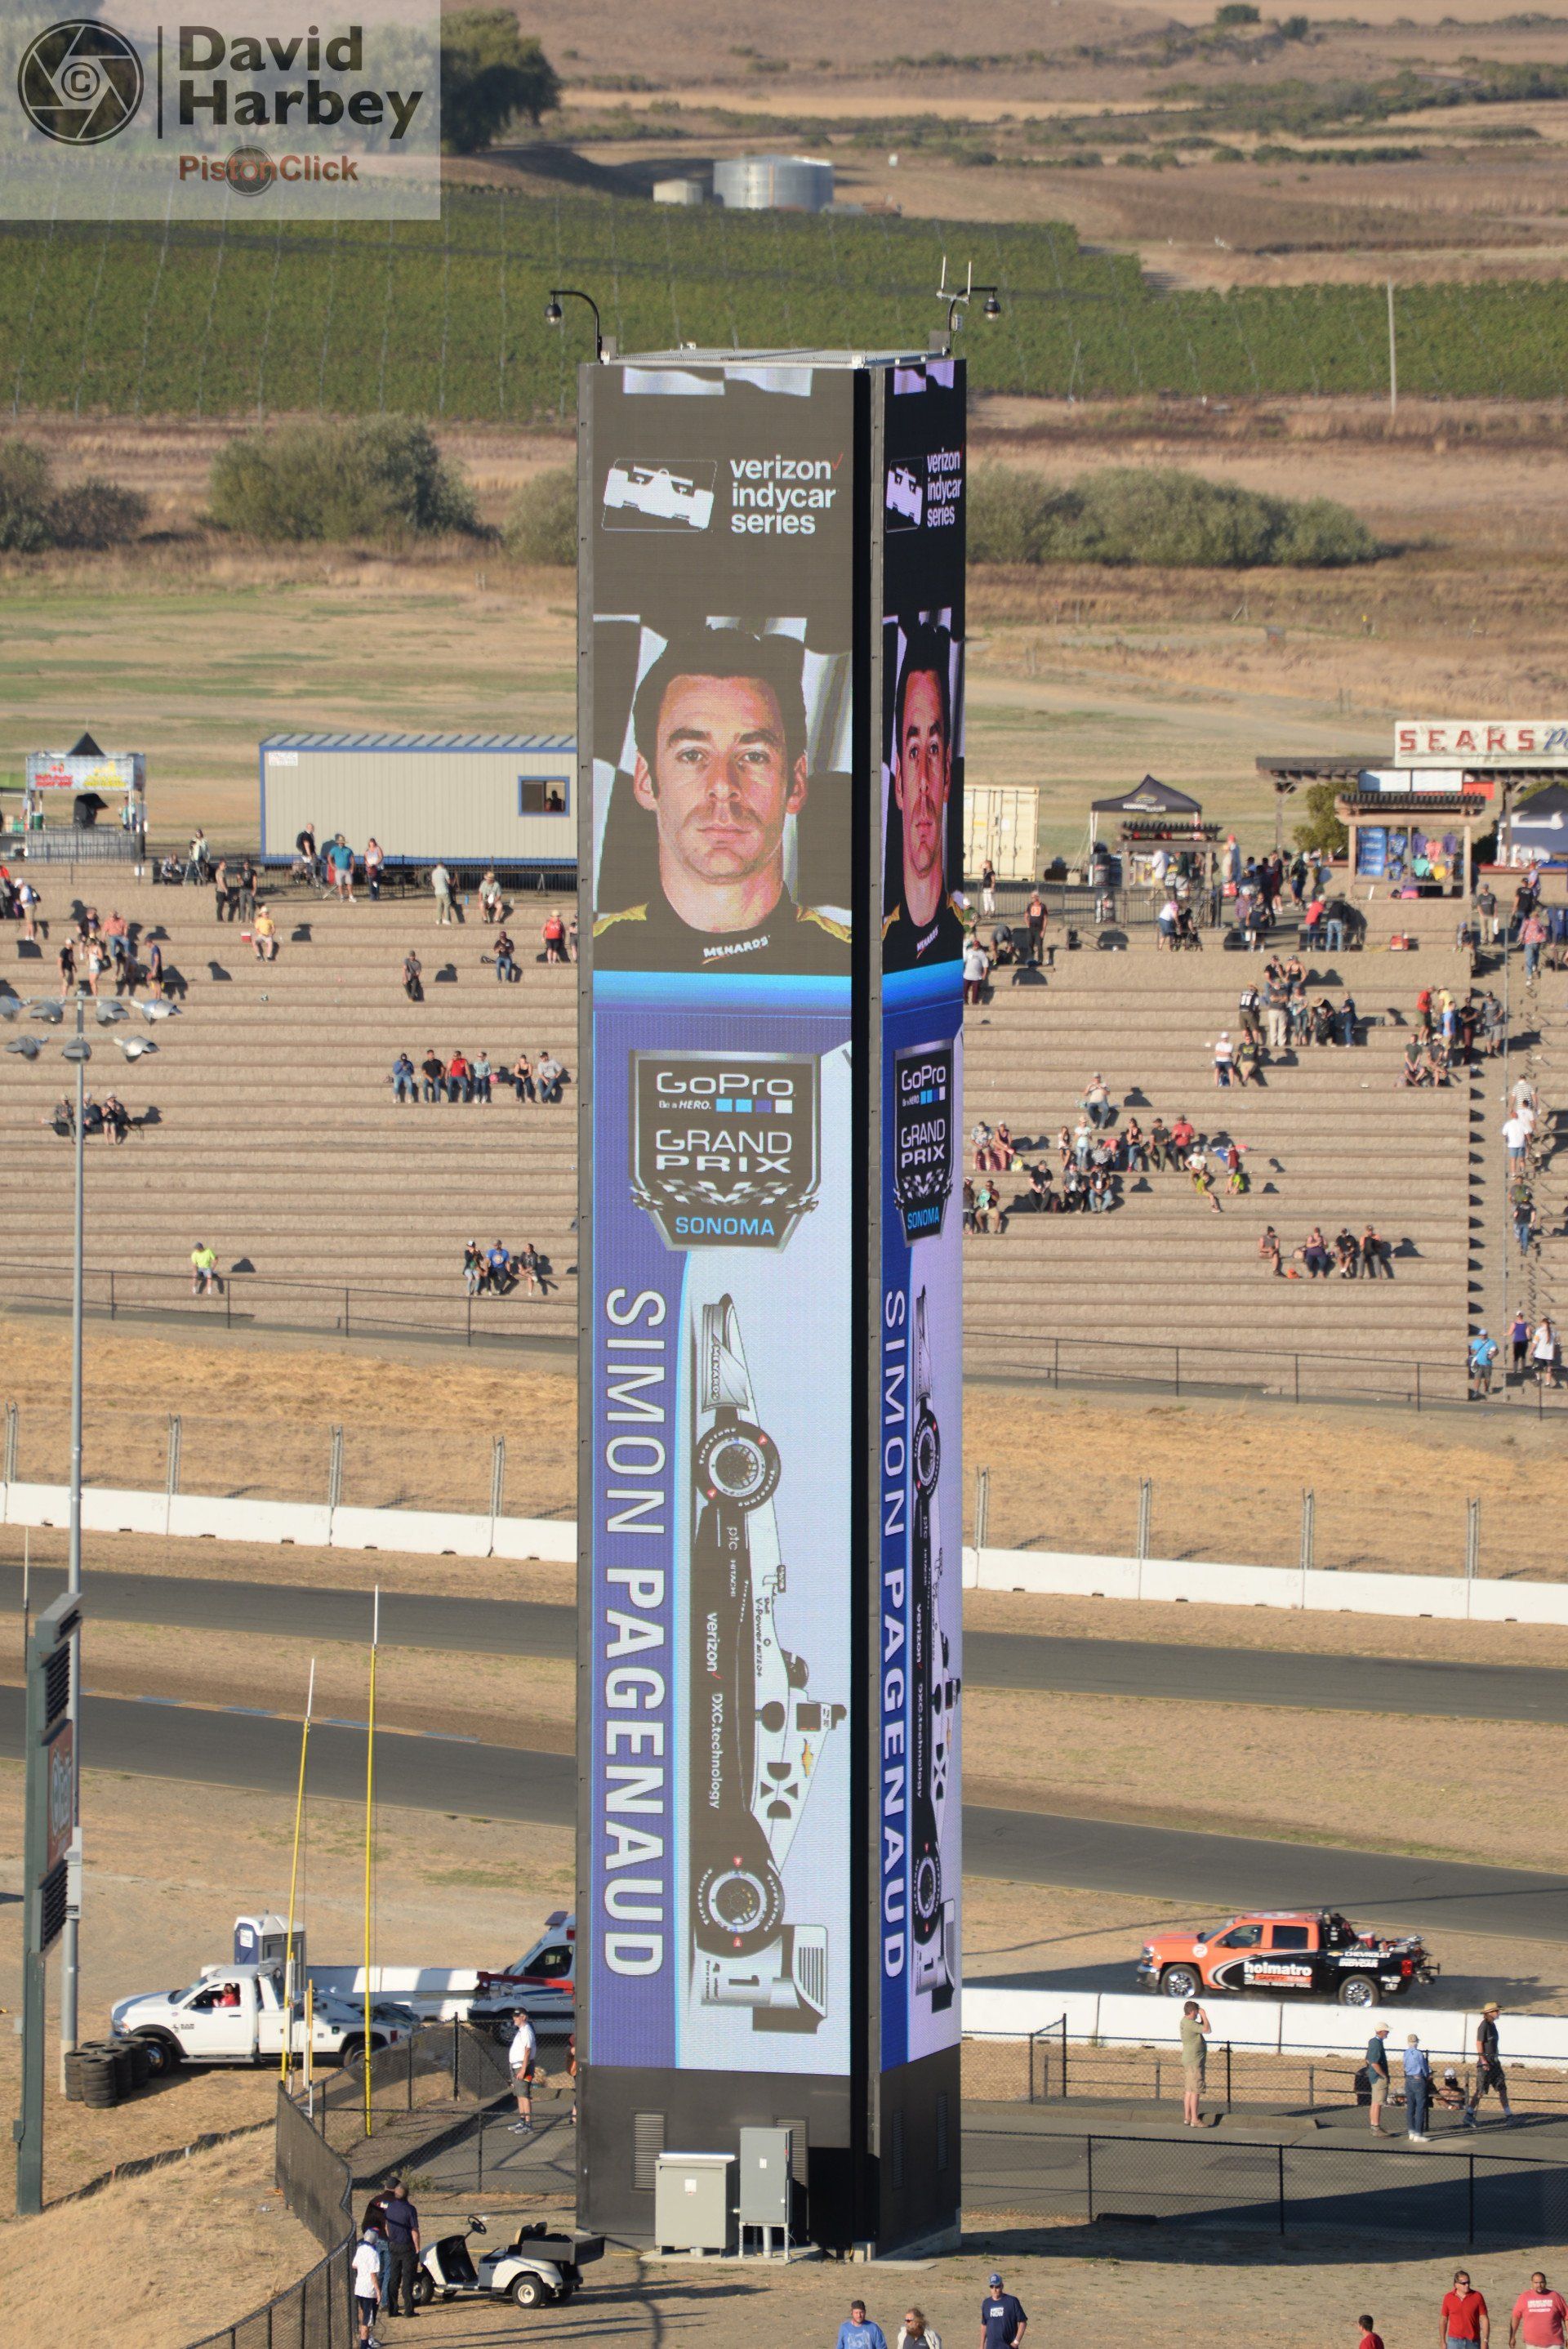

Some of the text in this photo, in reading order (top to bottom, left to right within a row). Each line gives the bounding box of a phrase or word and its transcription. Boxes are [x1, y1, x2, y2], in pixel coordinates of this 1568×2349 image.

[730, 454, 831, 480] verizon
[927, 446, 960, 475] verizon
[732, 482, 838, 512] indycar
[927, 476, 962, 503] indycar
[730, 511, 816, 535] series
[927, 504, 955, 528] series
[1399, 729, 1535, 751] SEARS
[703, 935, 770, 958] MENARDS
[657, 1072, 794, 1096] GoPro
[901, 1064, 947, 1091] GoPro
[656, 1130, 792, 1154] GRAND
[901, 1118, 946, 1148] GRAND
[656, 1154, 791, 1174] PRIX
[901, 1144, 945, 1168] PRIX
[675, 1216, 774, 1237] SONOMA
[906, 1206, 940, 1230] SONOMA
[604, 1288, 666, 1977] SIMON PAGENAUD
[706, 1612, 720, 1673] verizon
[884, 1290, 906, 1978] SIMON PAGENAUD
[709, 1693, 724, 1809] DXC.technology
[728, 1974, 760, 1987] 1
[1244, 1961, 1313, 1977] holmatro
